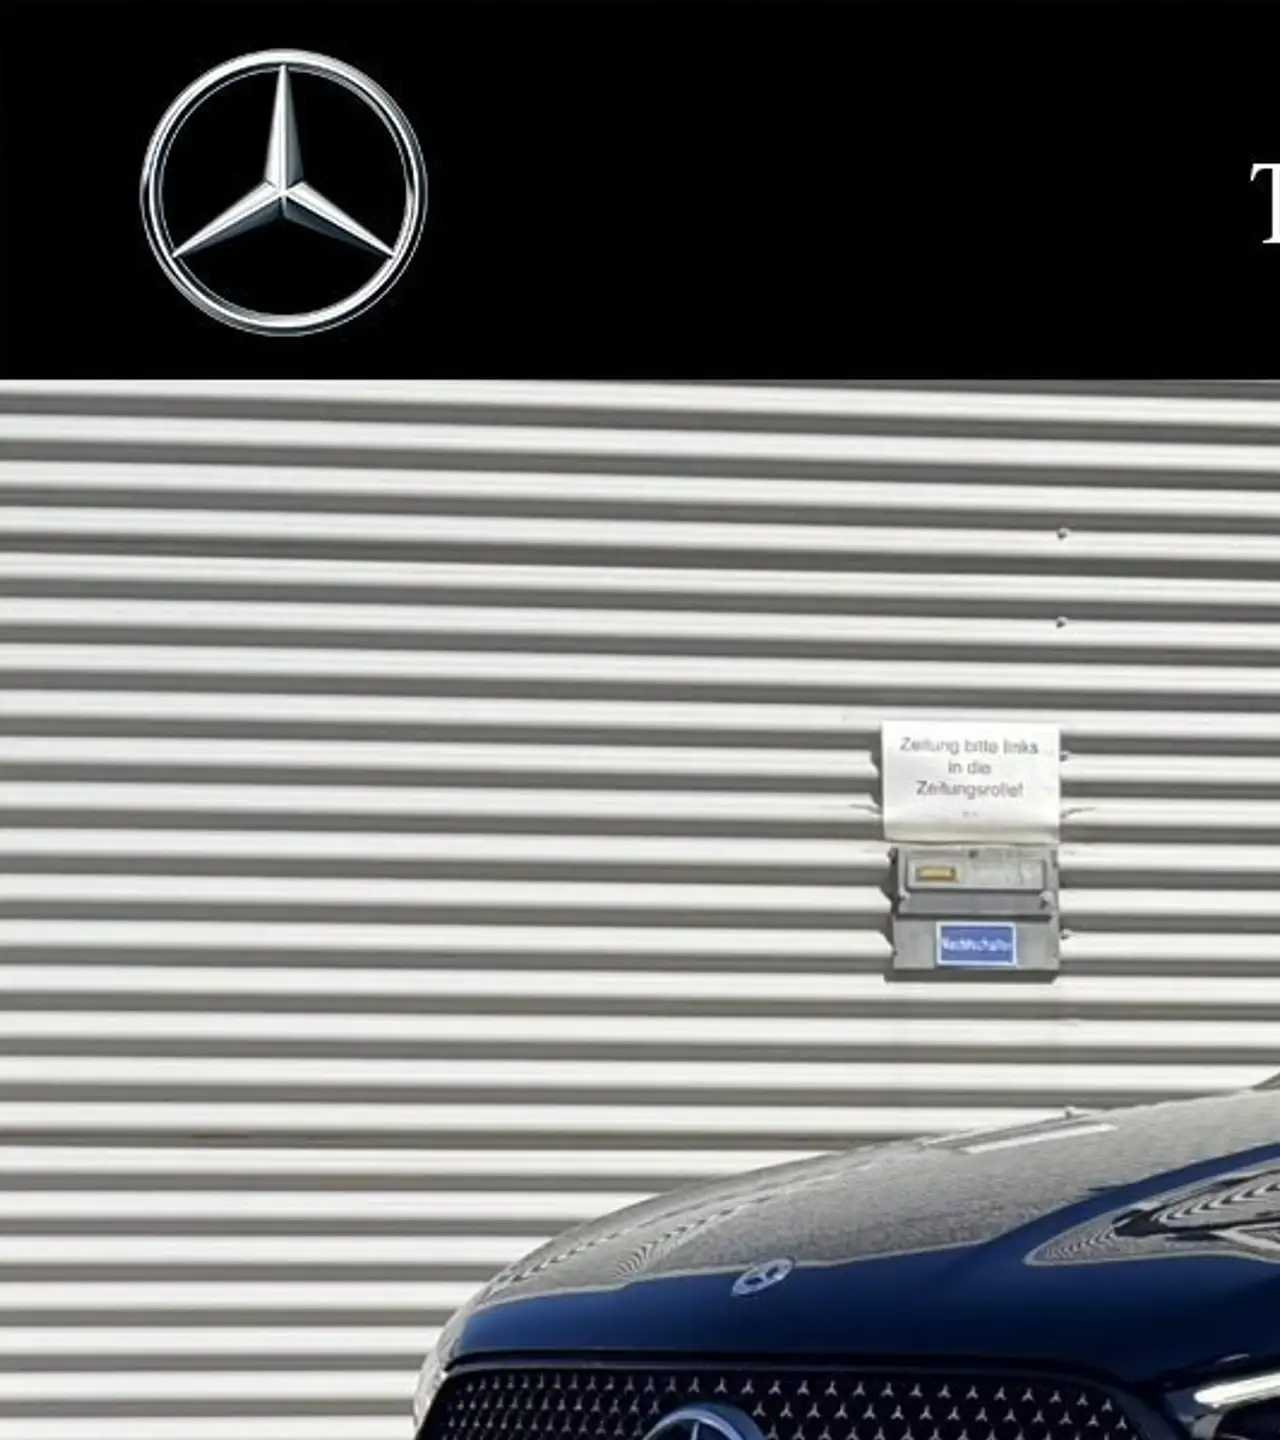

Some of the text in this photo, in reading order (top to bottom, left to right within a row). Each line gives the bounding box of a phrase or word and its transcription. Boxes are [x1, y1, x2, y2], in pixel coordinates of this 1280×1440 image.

[900, 737, 1039, 755] Zeitung bitte links
[967, 761, 992, 775] die
